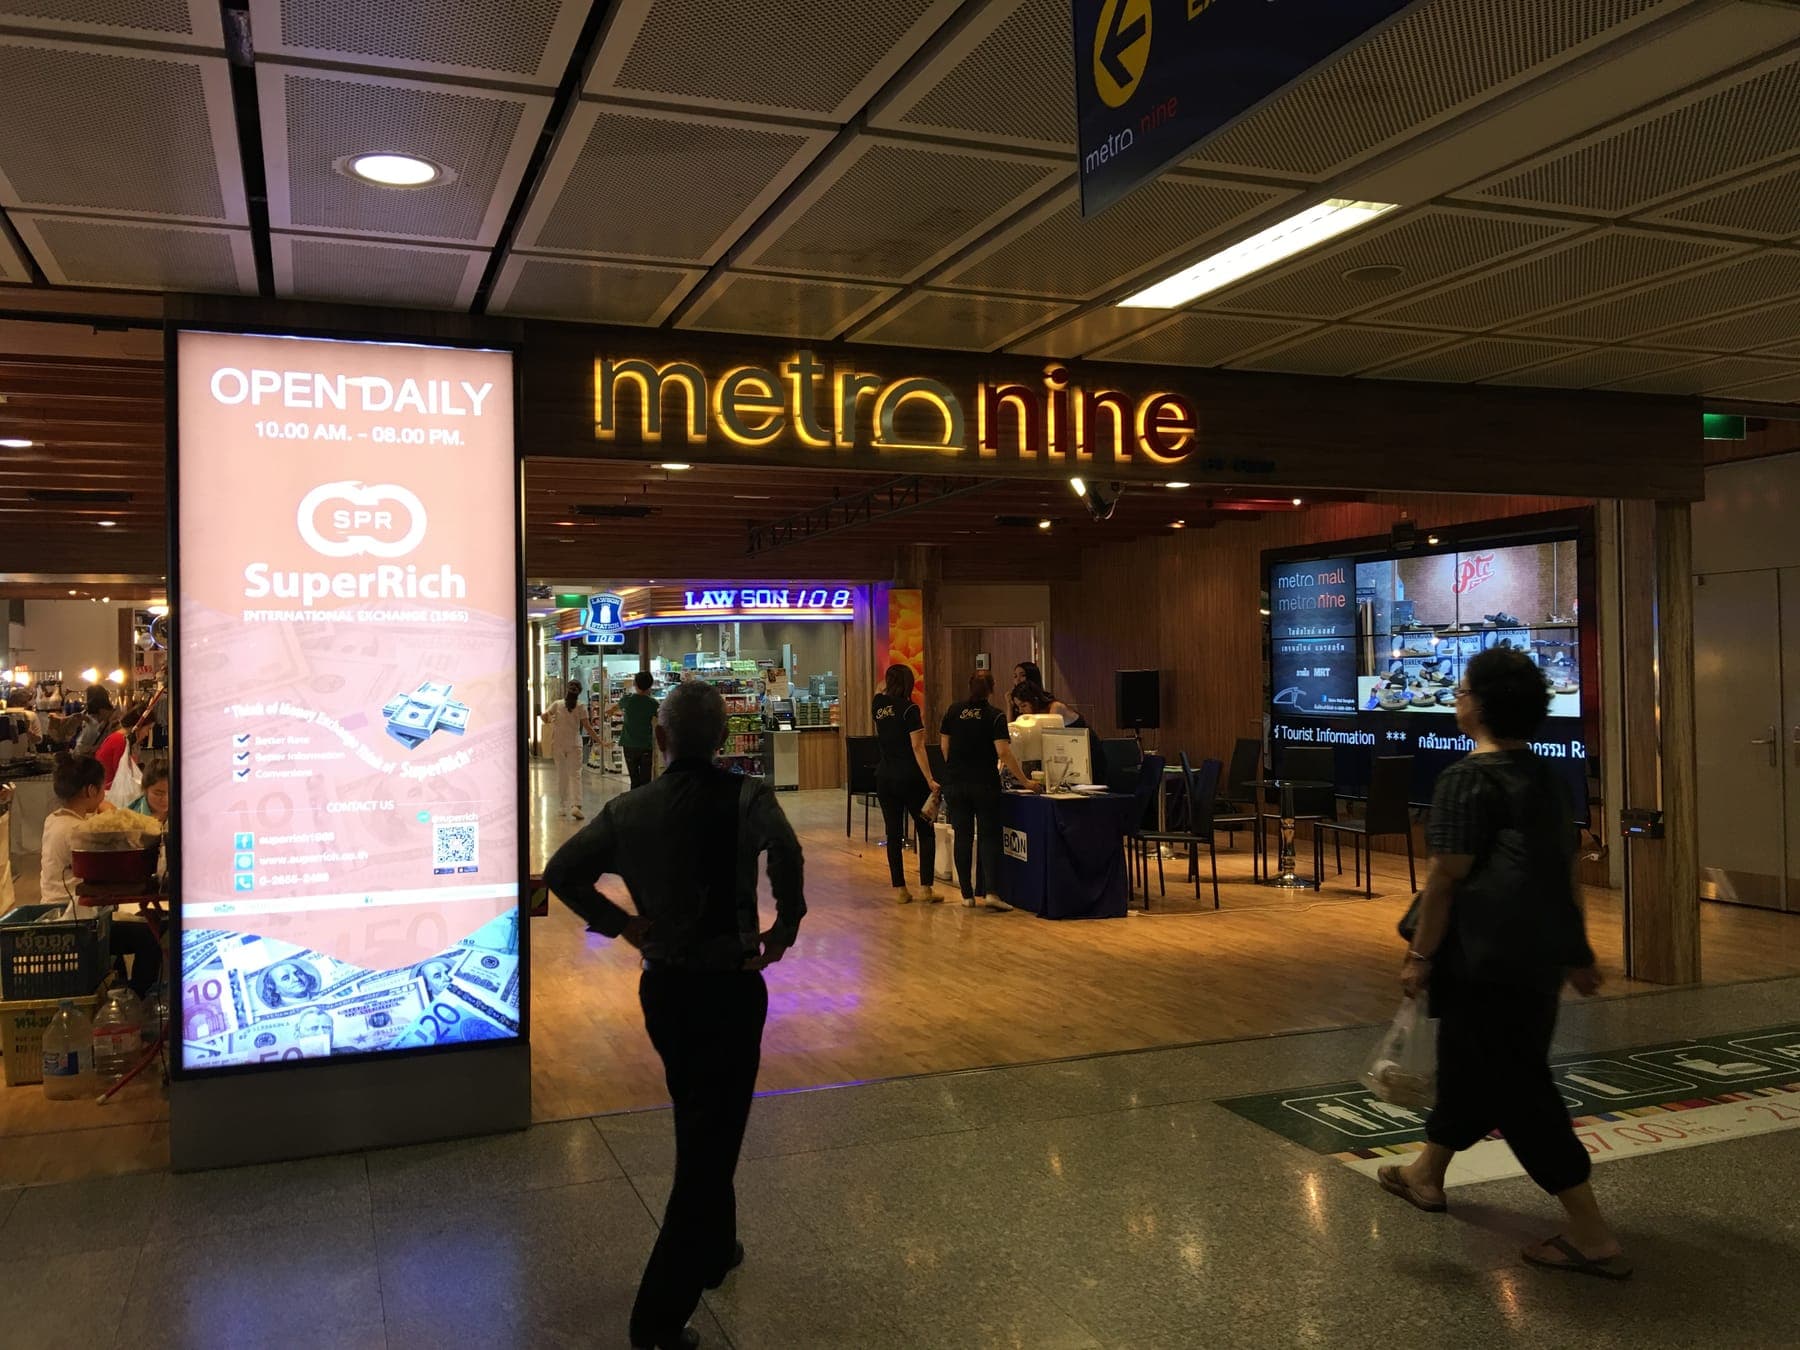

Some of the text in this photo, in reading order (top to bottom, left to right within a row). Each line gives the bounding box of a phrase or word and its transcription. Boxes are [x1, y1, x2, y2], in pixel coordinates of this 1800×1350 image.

[1084, 96, 1178, 174] metro nine
[210, 367, 493, 416] OPEN DAILY
[594, 350, 1198, 463] metro nine
[254, 421, 309, 440] 10.00
[313, 424, 352, 441] AM.
[371, 426, 425, 444] 08.00
[429, 428, 465, 446] PM.
[333, 510, 393, 530] SPR
[243, 562, 467, 606] SuperRich
[1278, 567, 1346, 589] metro mall
[1279, 592, 1346, 611] metro nine
[243, 610, 353, 622] INTERNATIONAL
[357, 611, 428, 623] EXCHANGE
[1281, 726, 1314, 742] Tourist
[1316, 728, 1375, 745] Information
[326, 799, 394, 813] CONTACT US
[188, 979, 222, 1006] 10
[420, 1002, 461, 1040] 20
